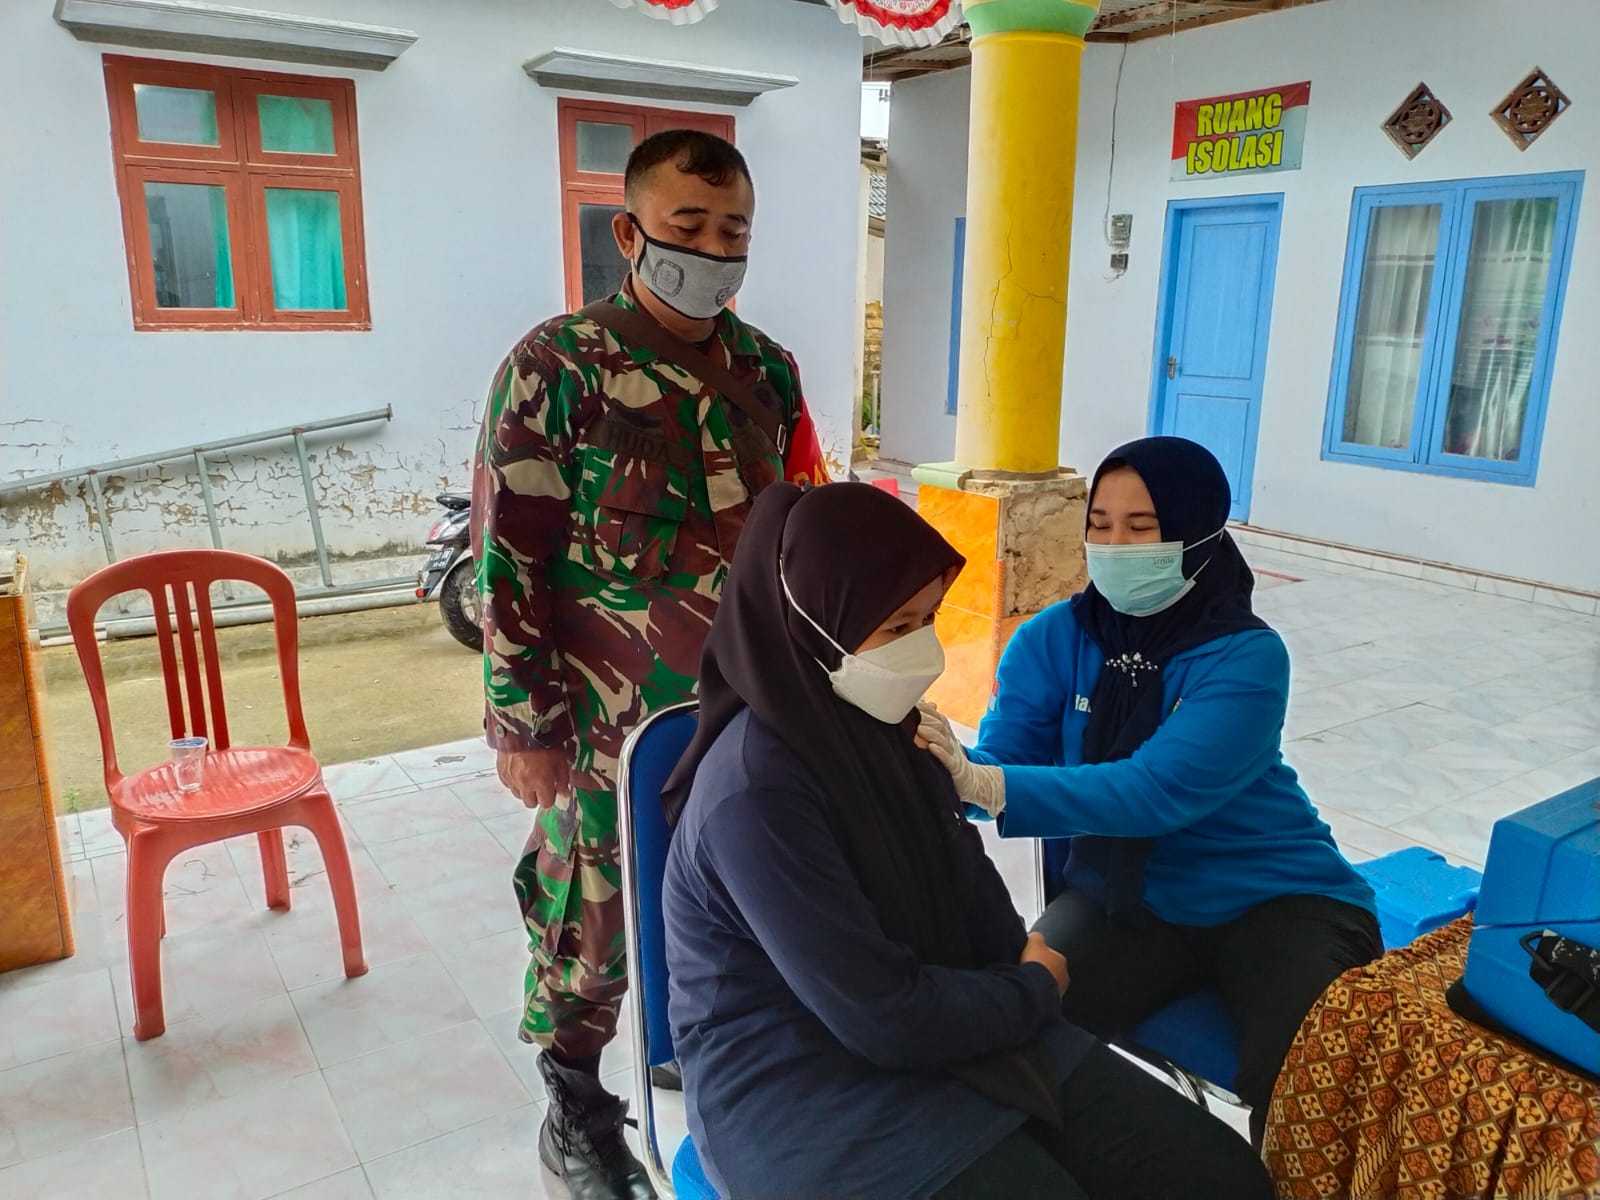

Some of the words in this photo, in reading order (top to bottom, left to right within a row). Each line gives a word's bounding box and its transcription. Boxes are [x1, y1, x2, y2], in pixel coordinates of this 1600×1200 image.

[1196, 92, 1284, 137] RUANG
[1186, 130, 1285, 175] ISOLASI
[608, 425, 671, 462] HUDA
